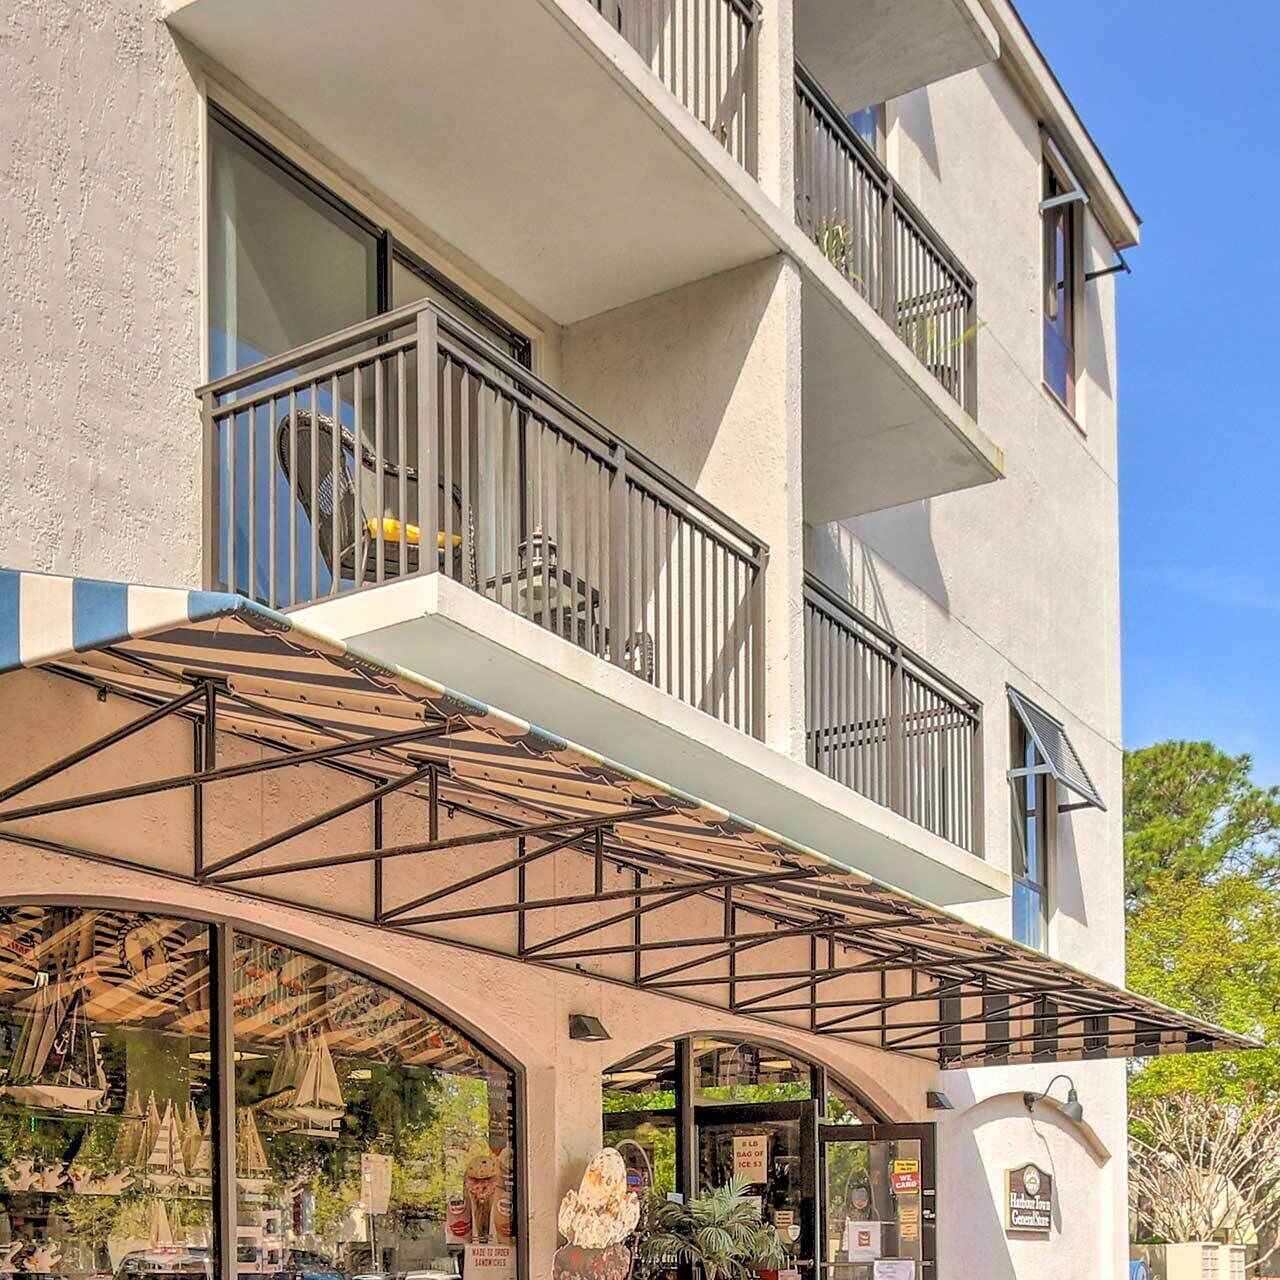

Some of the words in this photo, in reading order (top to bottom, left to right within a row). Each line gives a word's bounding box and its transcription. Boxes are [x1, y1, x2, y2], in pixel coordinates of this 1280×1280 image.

[896, 1180, 917, 1189] CARD
[1034, 1195, 1050, 1210] Town
[1012, 1210, 1034, 1226] General
[1034, 1211, 1049, 1226] Store
